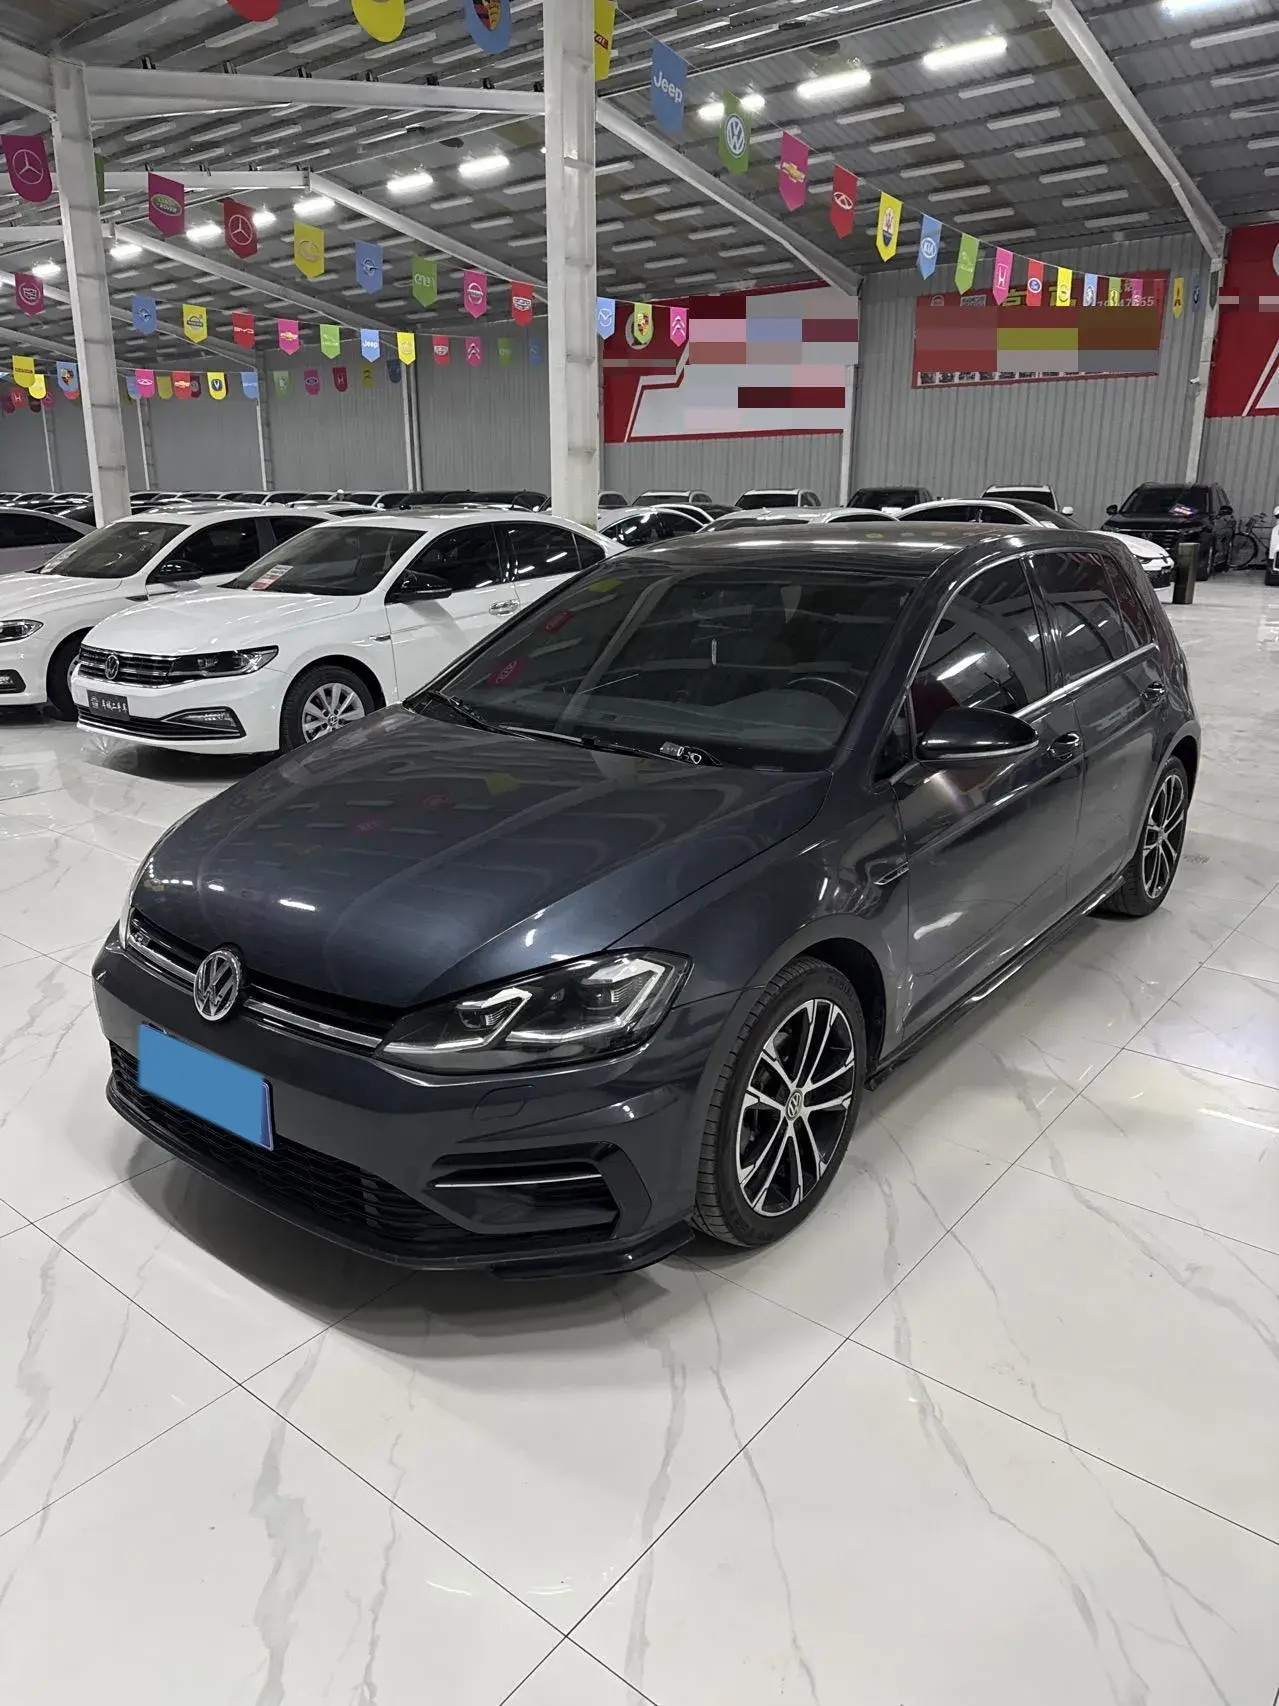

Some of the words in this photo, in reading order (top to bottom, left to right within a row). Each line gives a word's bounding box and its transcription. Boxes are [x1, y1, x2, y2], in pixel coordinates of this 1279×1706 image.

[653, 71, 683, 103] Jeep
[233, 326, 254, 334] BYD
[363, 340, 378, 349] Jeep
